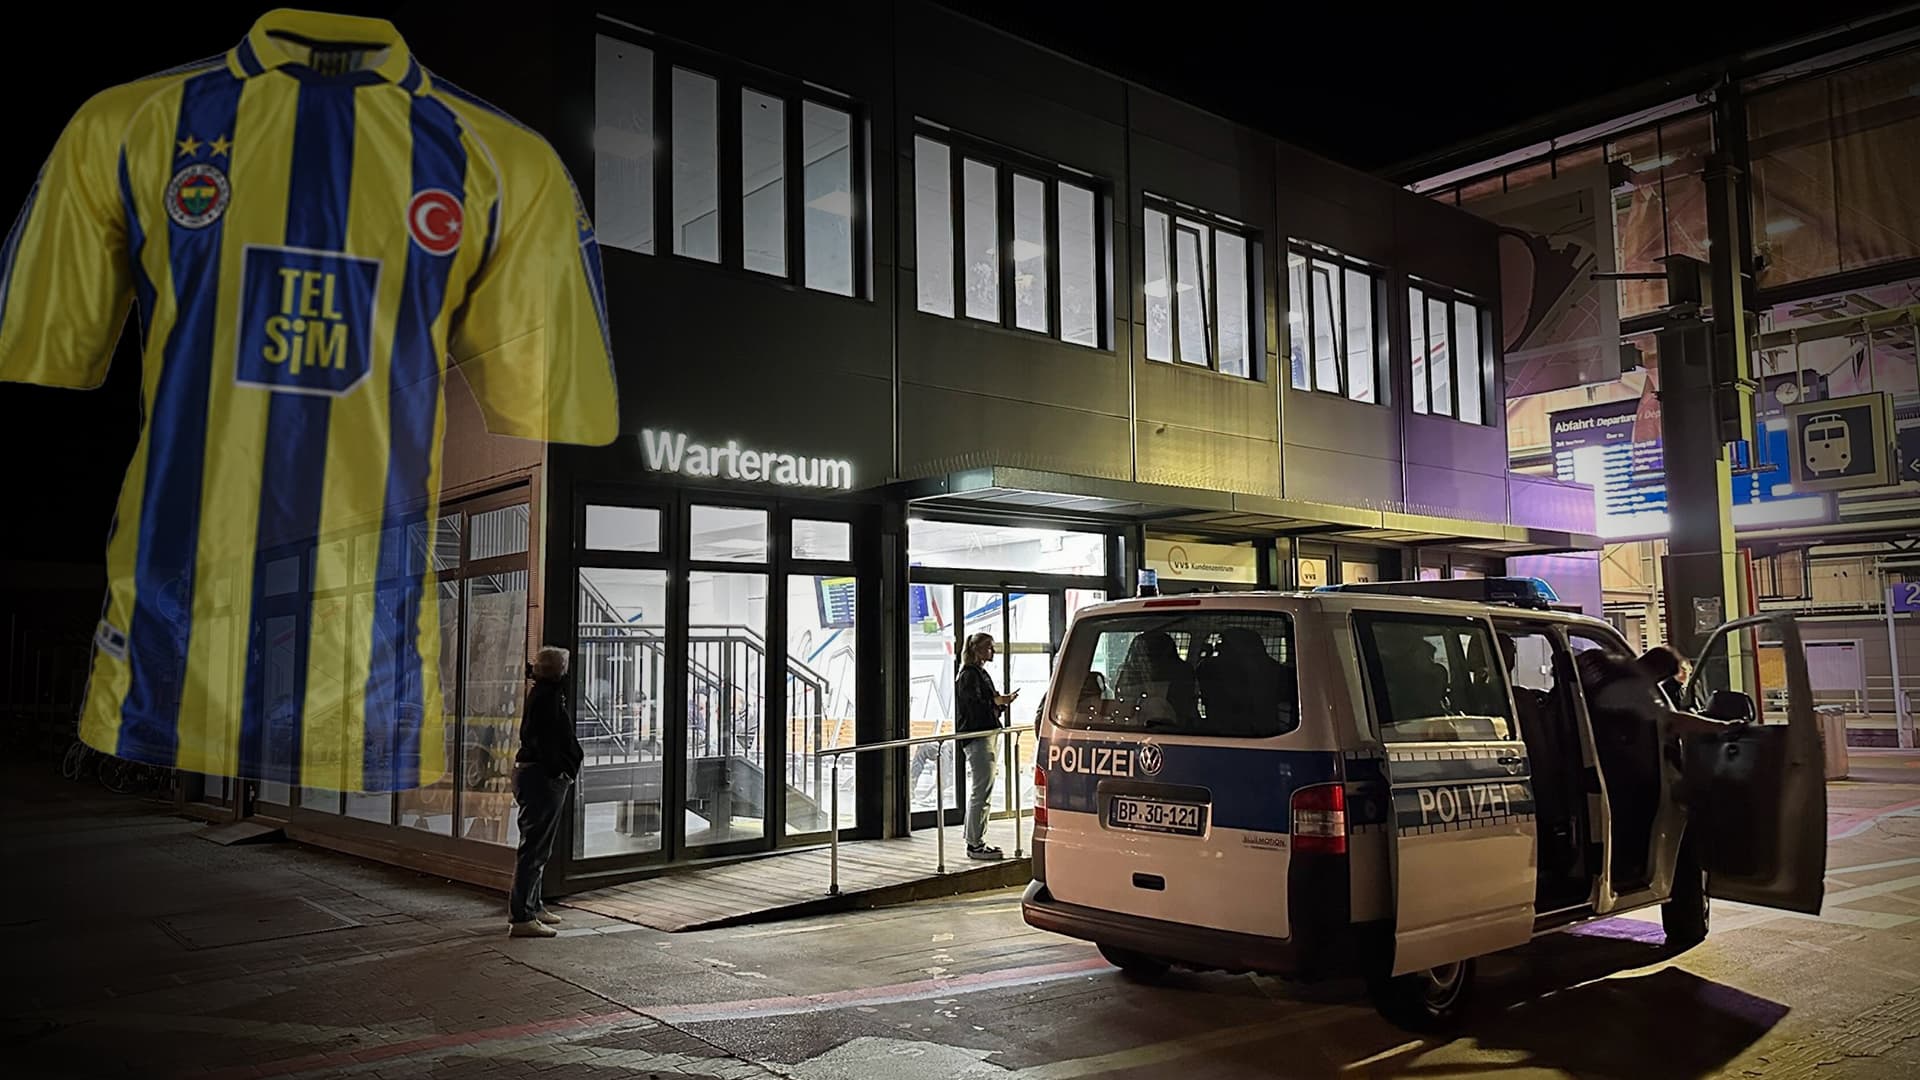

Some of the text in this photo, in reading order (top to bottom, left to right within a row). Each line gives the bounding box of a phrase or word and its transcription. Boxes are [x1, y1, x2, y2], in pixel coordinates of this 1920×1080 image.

[279, 268, 342, 320] TEL
[1555, 418, 1595, 433] Abfahrt
[642, 429, 852, 490] Warteraum
[1174, 561, 1234, 573] VVS Kundenzentrum
[1048, 745, 1135, 777] POLIZEI
[1417, 783, 1511, 824] POLIZEI
